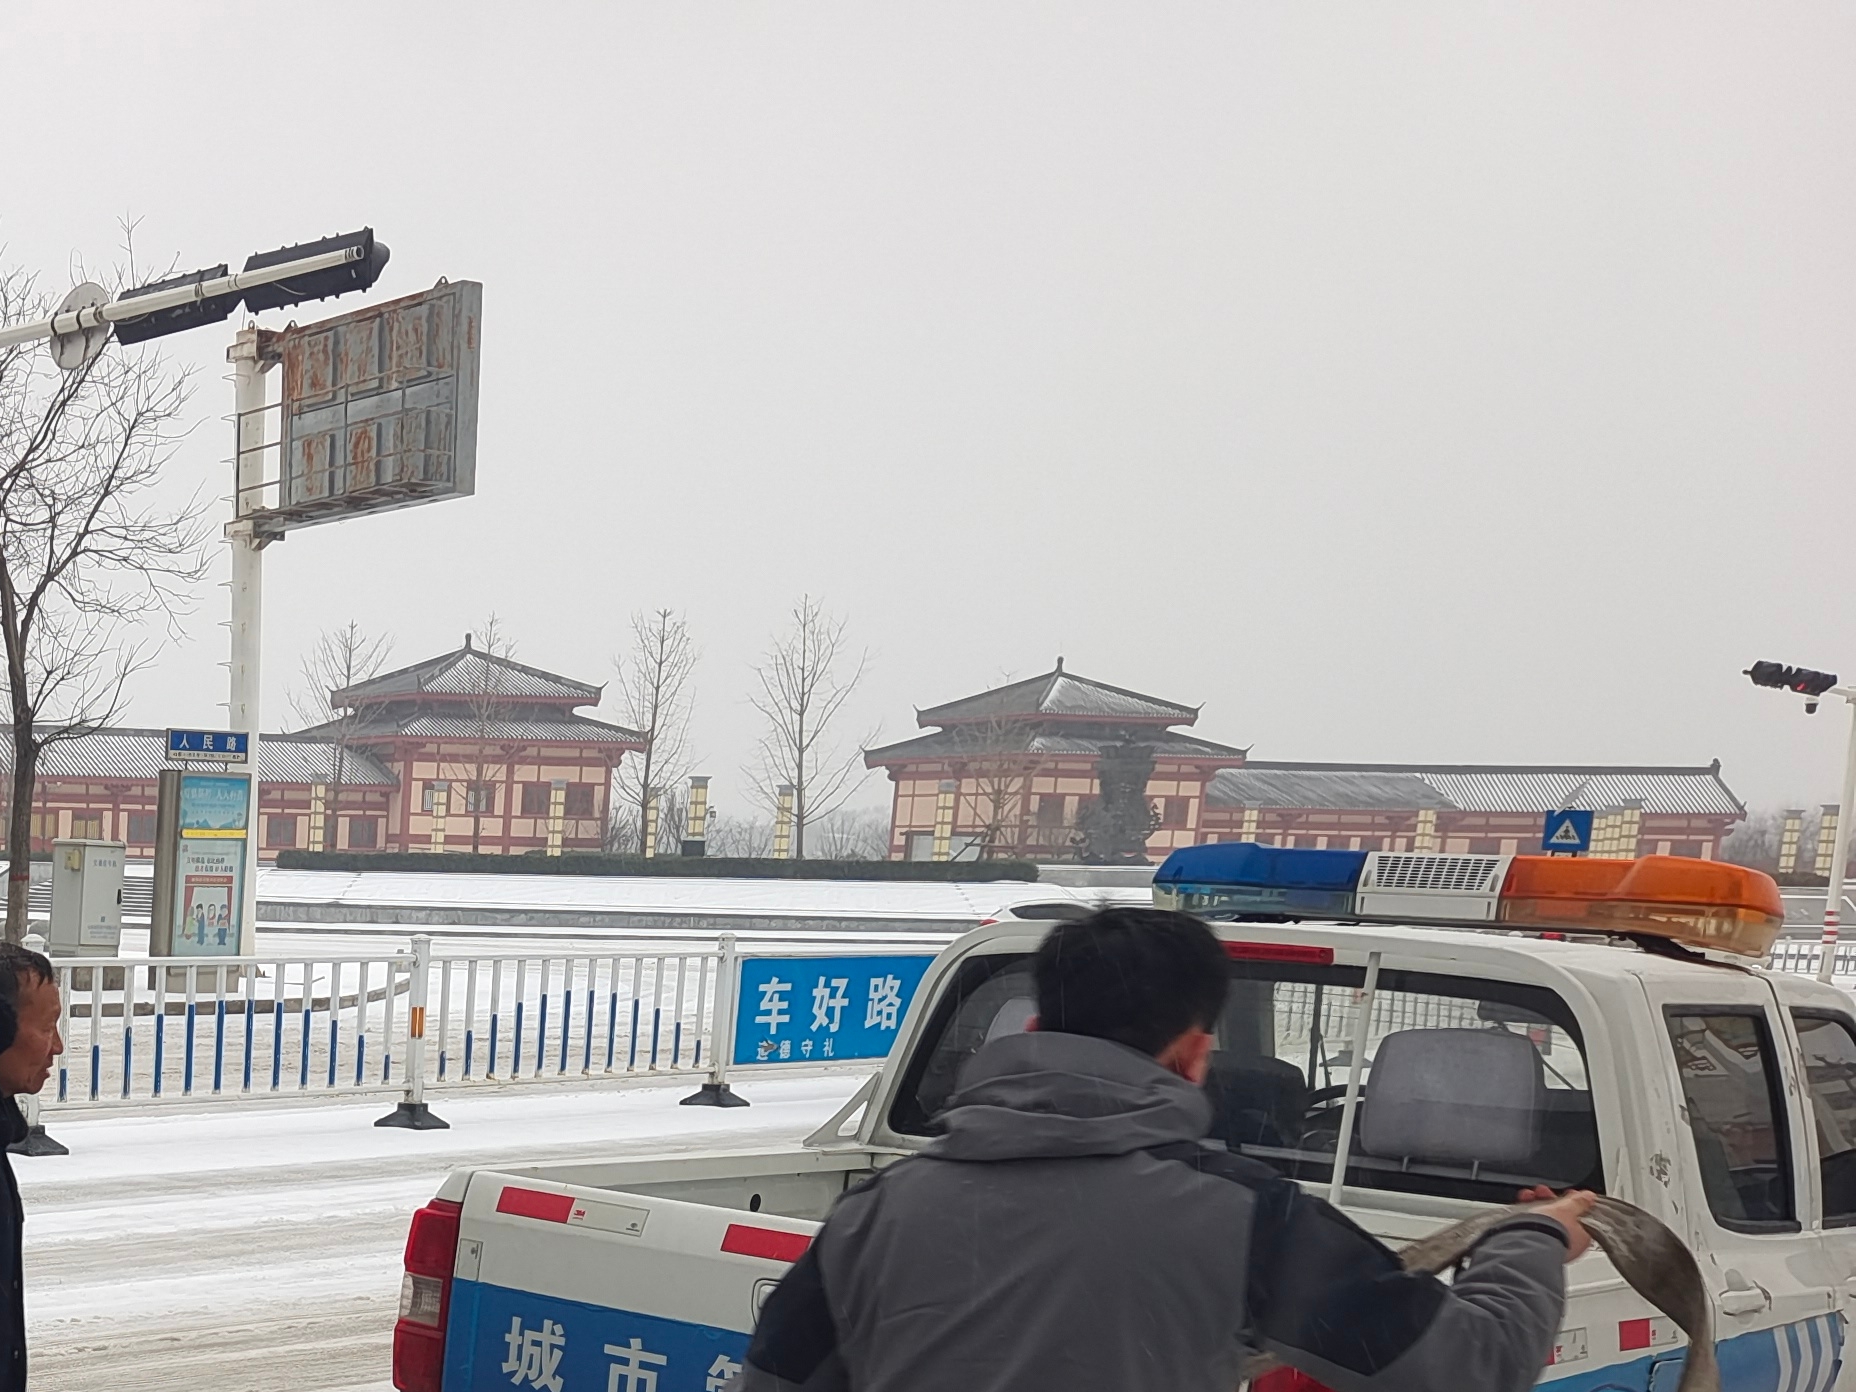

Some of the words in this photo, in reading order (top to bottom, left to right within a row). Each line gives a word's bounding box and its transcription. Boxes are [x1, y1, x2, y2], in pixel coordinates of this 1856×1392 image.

[178, 733, 237, 751] 人民路
[754, 974, 902, 1035] 车好路
